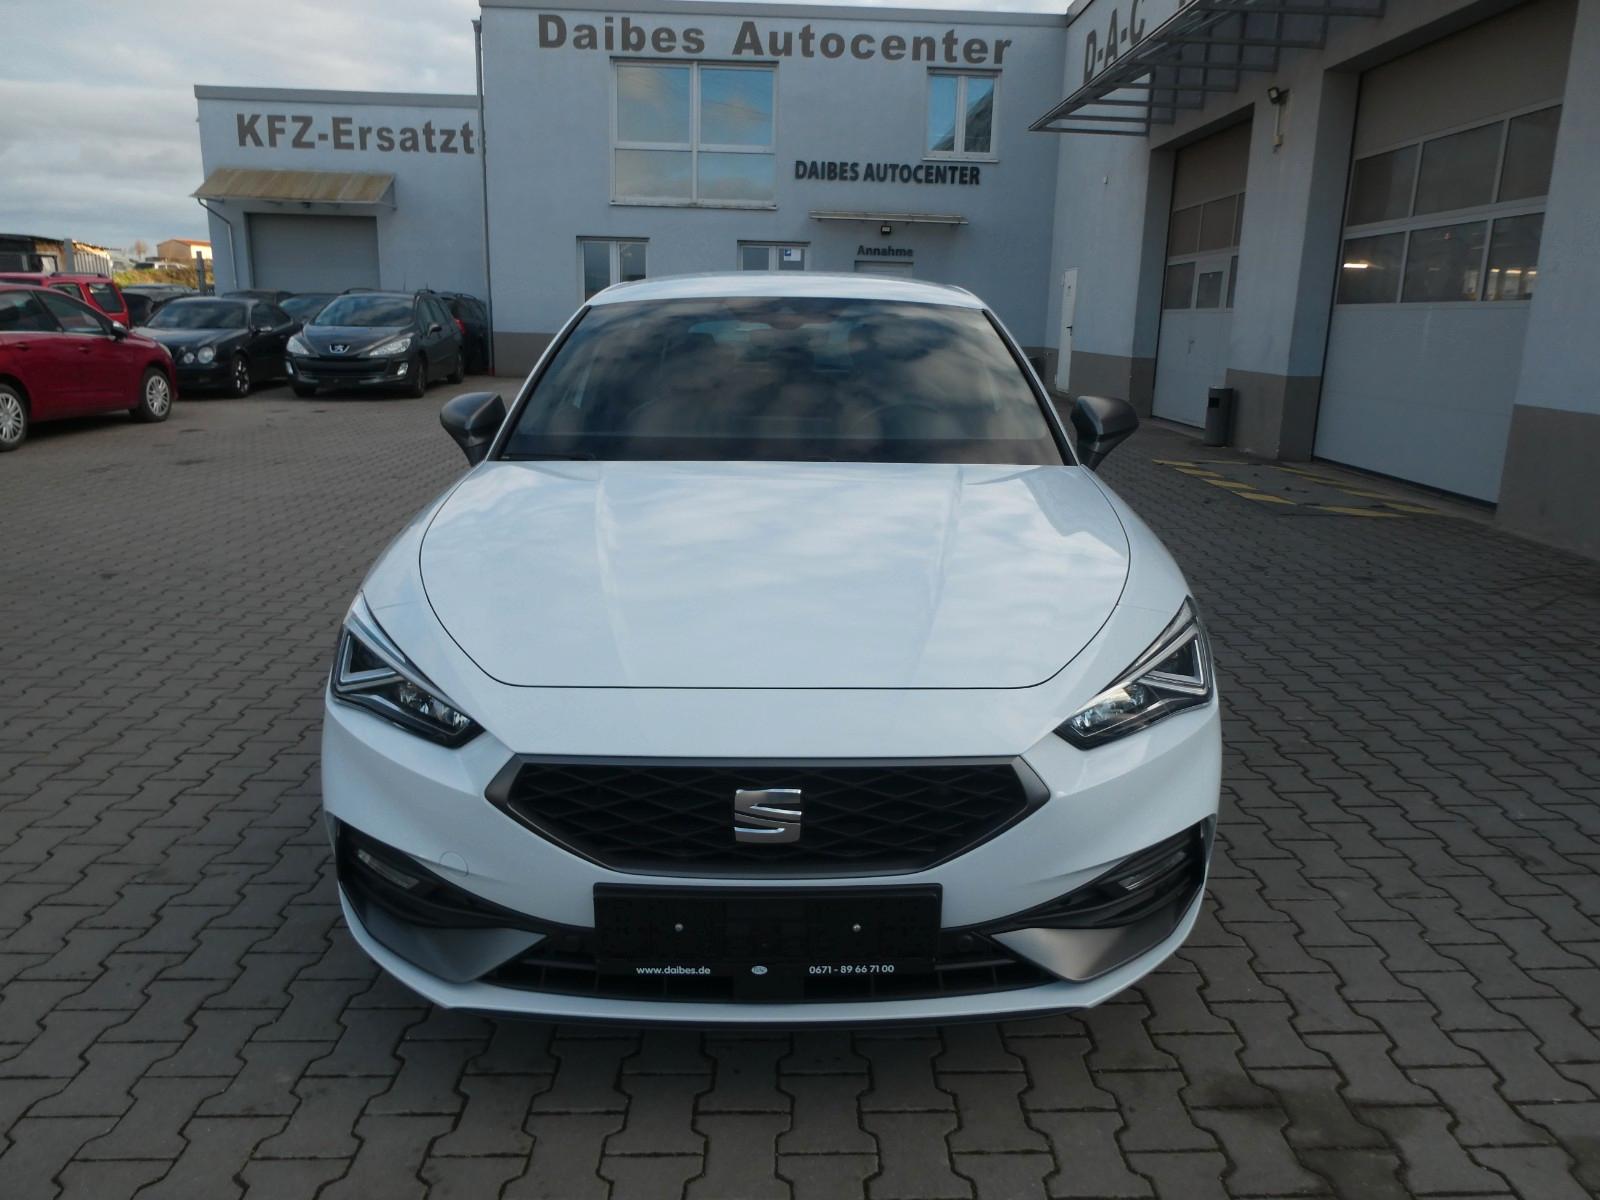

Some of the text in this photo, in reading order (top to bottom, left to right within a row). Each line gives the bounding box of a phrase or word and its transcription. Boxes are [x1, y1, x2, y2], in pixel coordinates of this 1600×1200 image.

[537, 13, 1012, 65] Daibes Autocenter
[236, 113, 481, 155] KFZ-Ersatzt
[795, 160, 981, 186] DAIBES AUTOCENTER
[856, 244, 913, 257] Annahme
[636, 965, 711, 975] www.daibes.de
[809, 965, 832, 974] 0671
[840, 965, 853, 974] 89
[854, 965, 868, 973] 66
[869, 964, 880, 973] 71
[881, 964, 895, 973] 00
